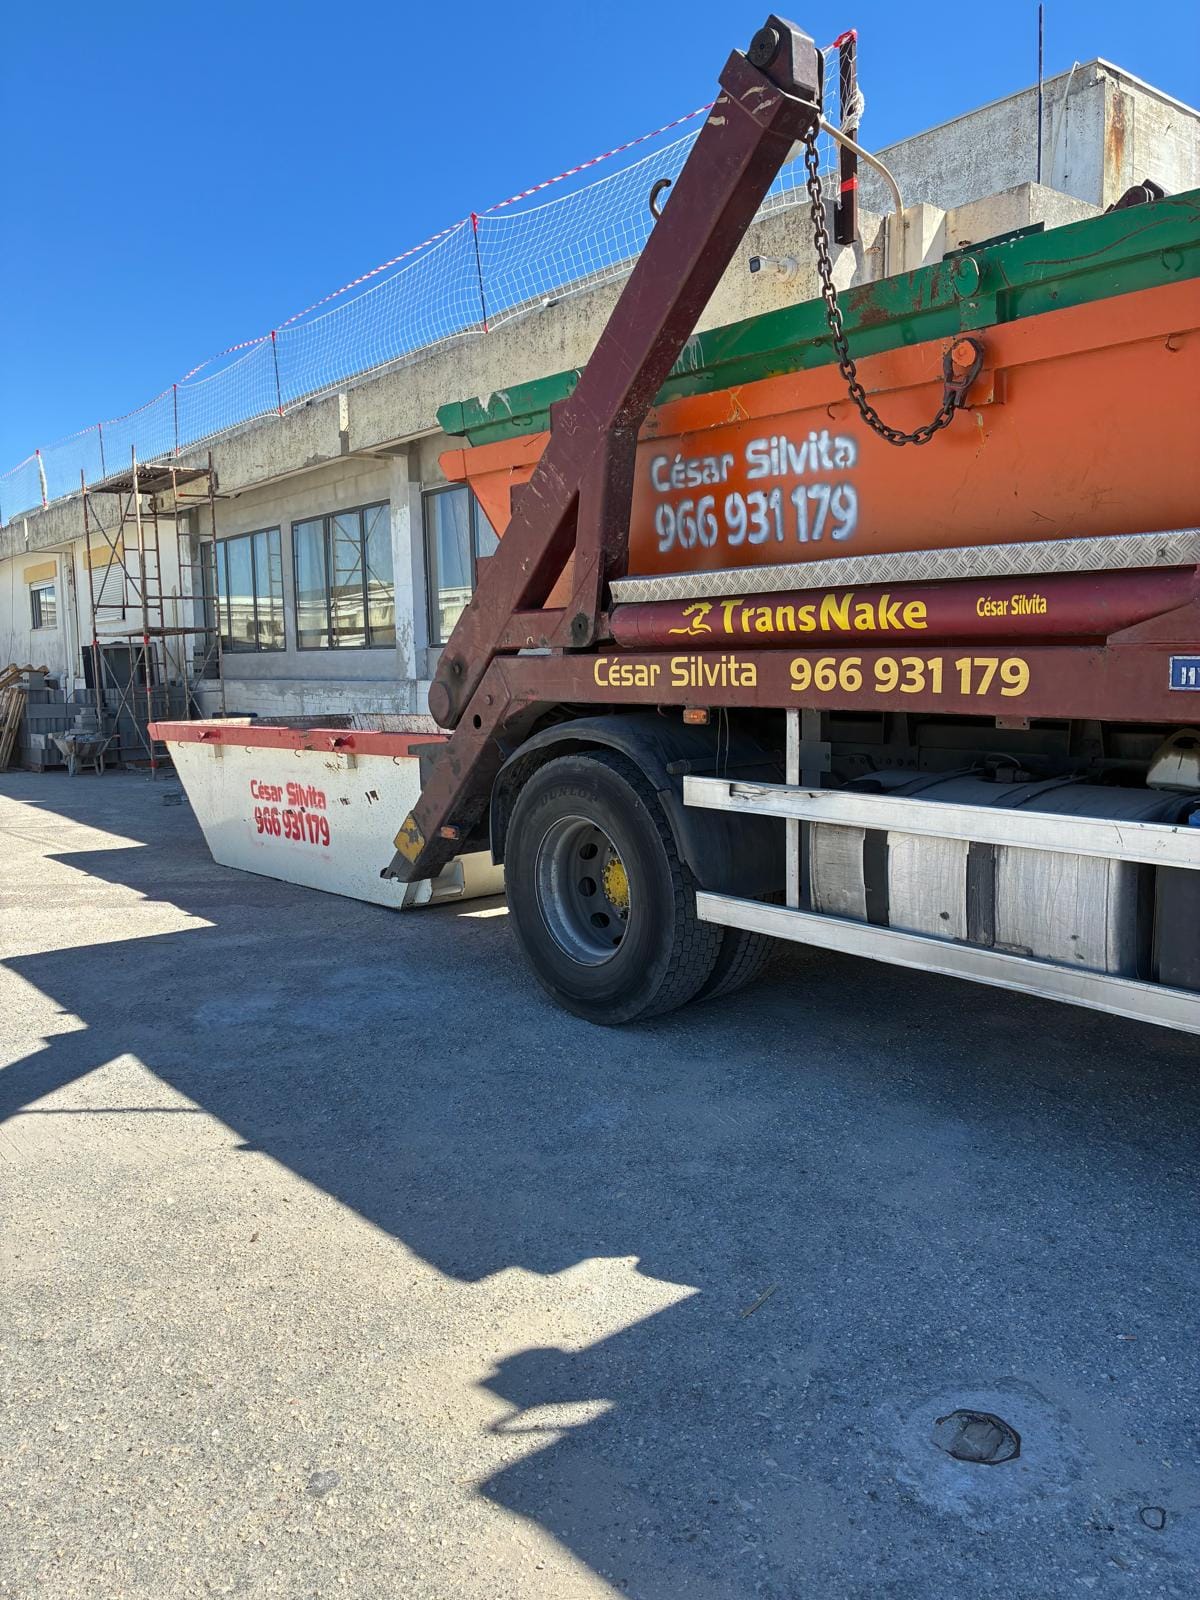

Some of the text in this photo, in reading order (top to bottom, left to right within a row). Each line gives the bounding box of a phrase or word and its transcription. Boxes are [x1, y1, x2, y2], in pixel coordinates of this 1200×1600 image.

[652, 430, 857, 492] César Silvita
[655, 483, 858, 553] 966 931 179
[720, 593, 928, 634] TransNake
[976, 593, 1047, 617] César Silvita
[593, 655, 757, 687] César Silvita
[789, 656, 1030, 697] 966 931 179
[250, 779, 327, 810] César Silvita
[255, 807, 330, 847] 966 931 179
